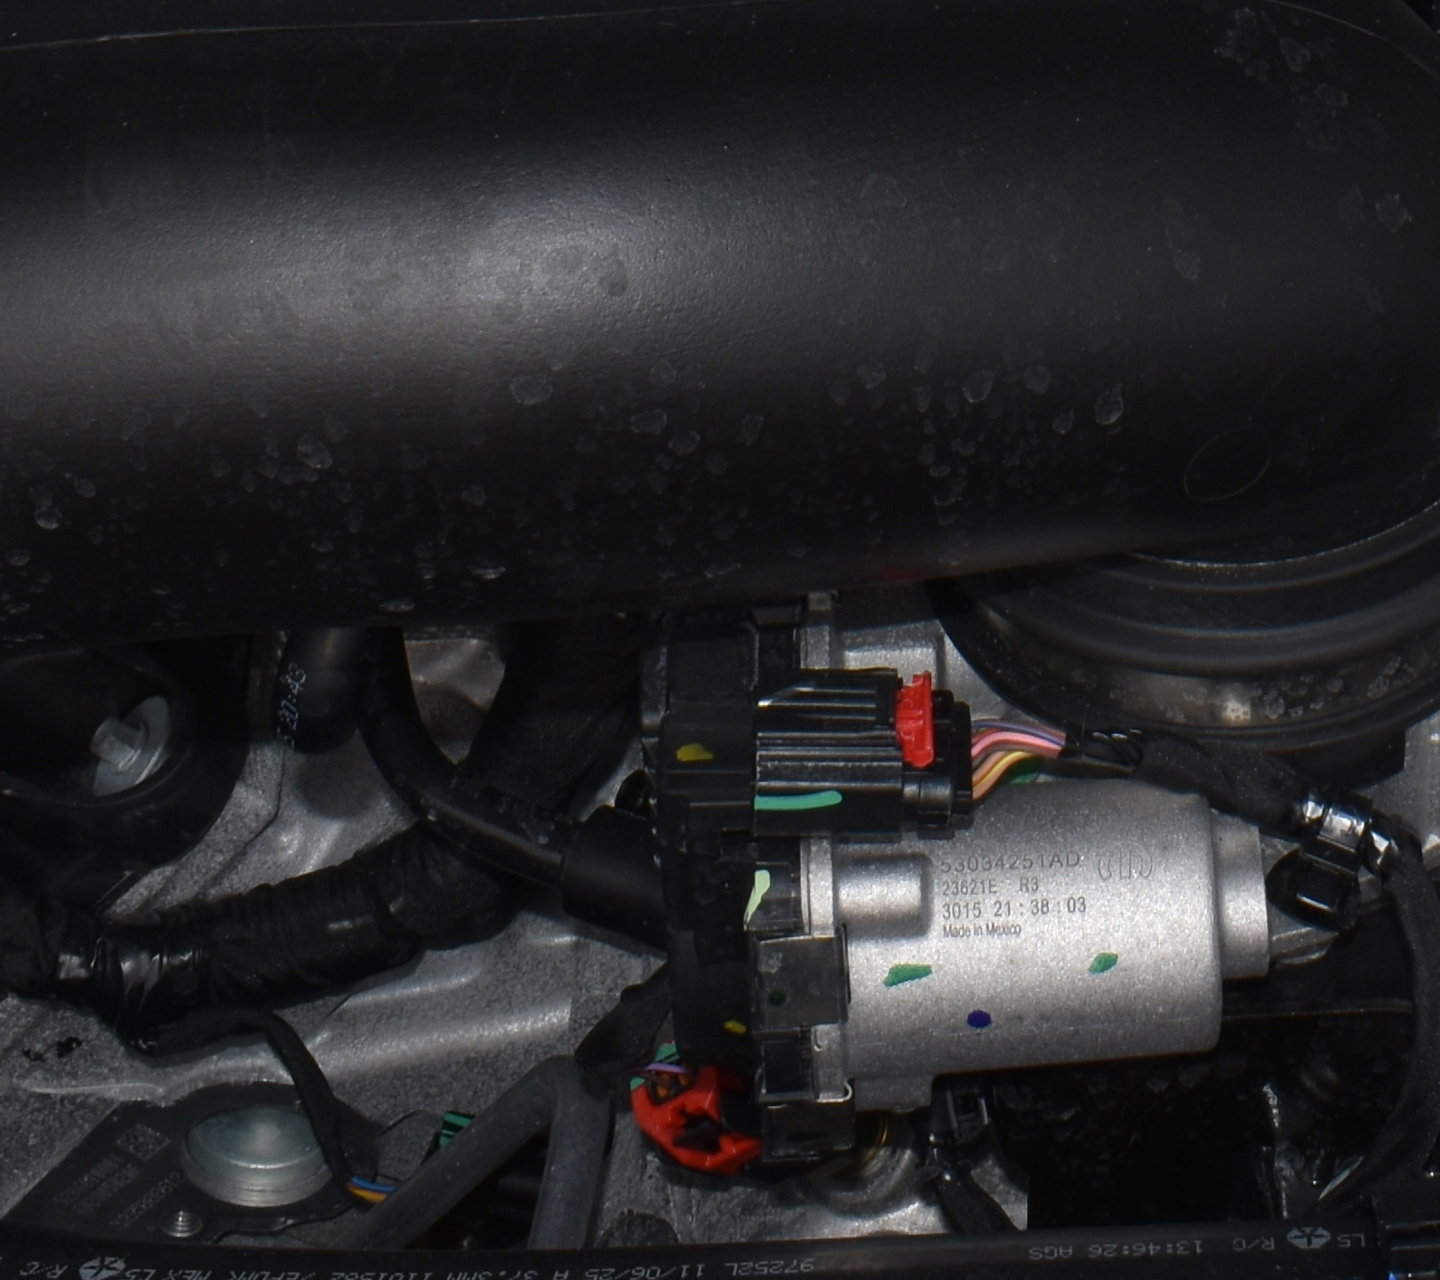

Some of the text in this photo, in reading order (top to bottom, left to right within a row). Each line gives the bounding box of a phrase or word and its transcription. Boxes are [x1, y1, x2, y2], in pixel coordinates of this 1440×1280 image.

[941, 850, 1081, 873] 53034251AD
[943, 876, 1040, 897] 23621E R3
[943, 901, 982, 920] 3015
[943, 924, 972, 939] Made
[986, 920, 1022, 937] Mexico
[1028, 1231, 1367, 1261] L5 R/C 13:46:26 AGS
[723, 1258, 815, 1278] 97252L
